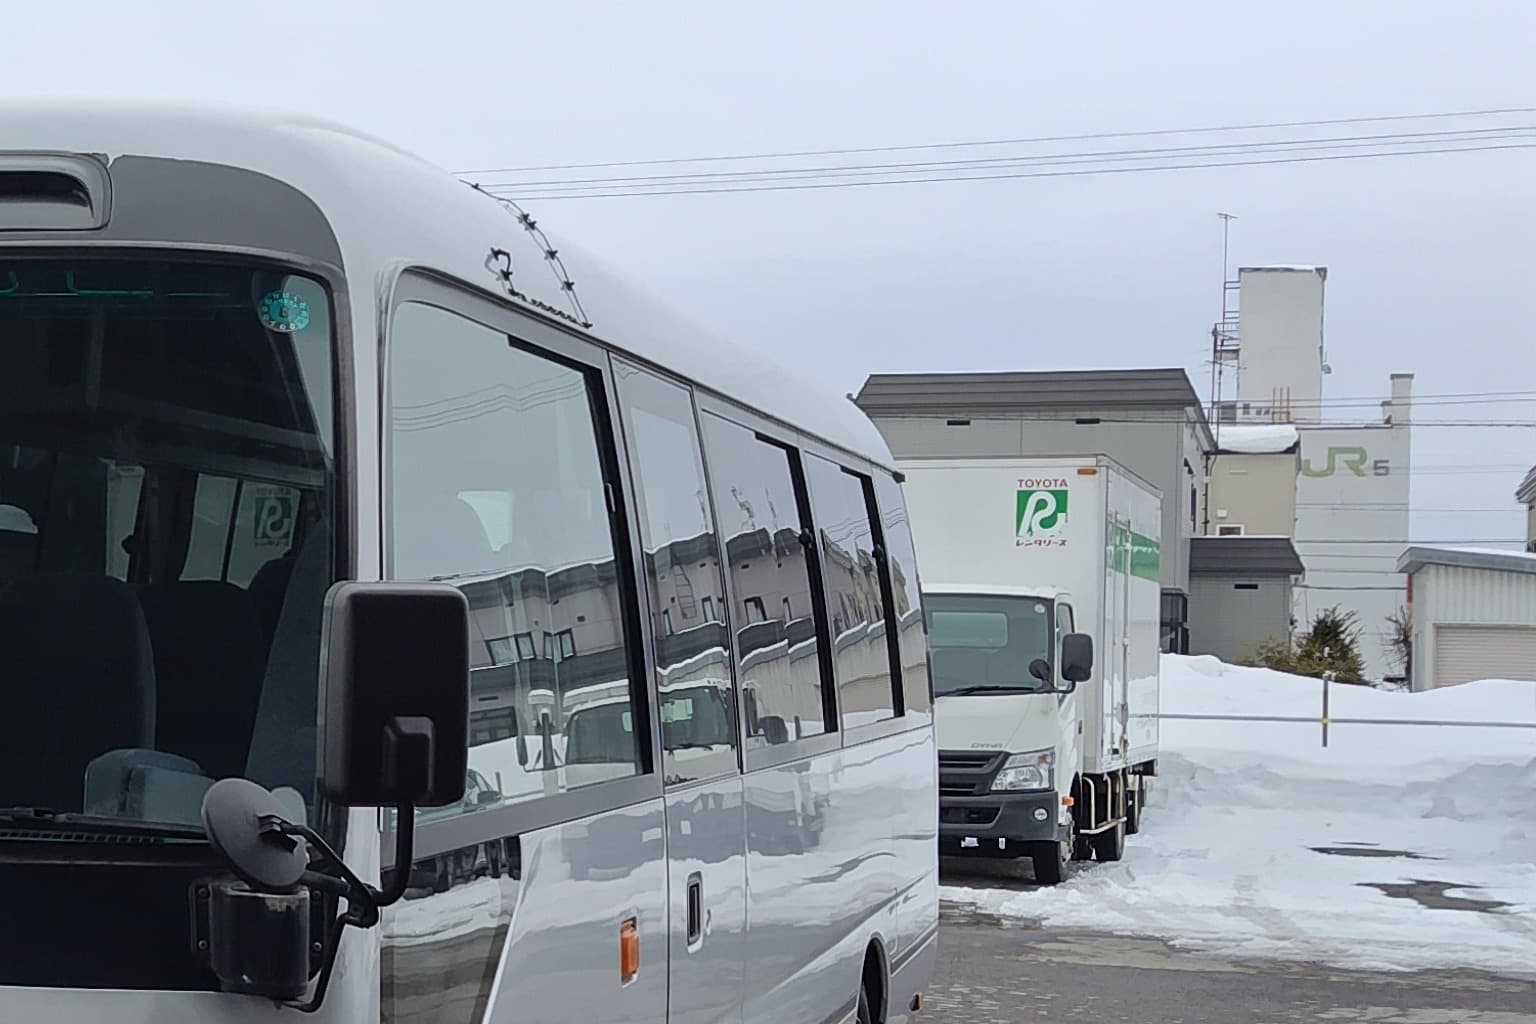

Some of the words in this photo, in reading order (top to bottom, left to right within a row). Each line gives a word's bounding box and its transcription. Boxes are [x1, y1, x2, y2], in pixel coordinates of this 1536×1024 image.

[1301, 446, 1368, 478] JR
[1016, 478, 1068, 488] TOYOTA
[1015, 539, 1067, 547] レンタリース
